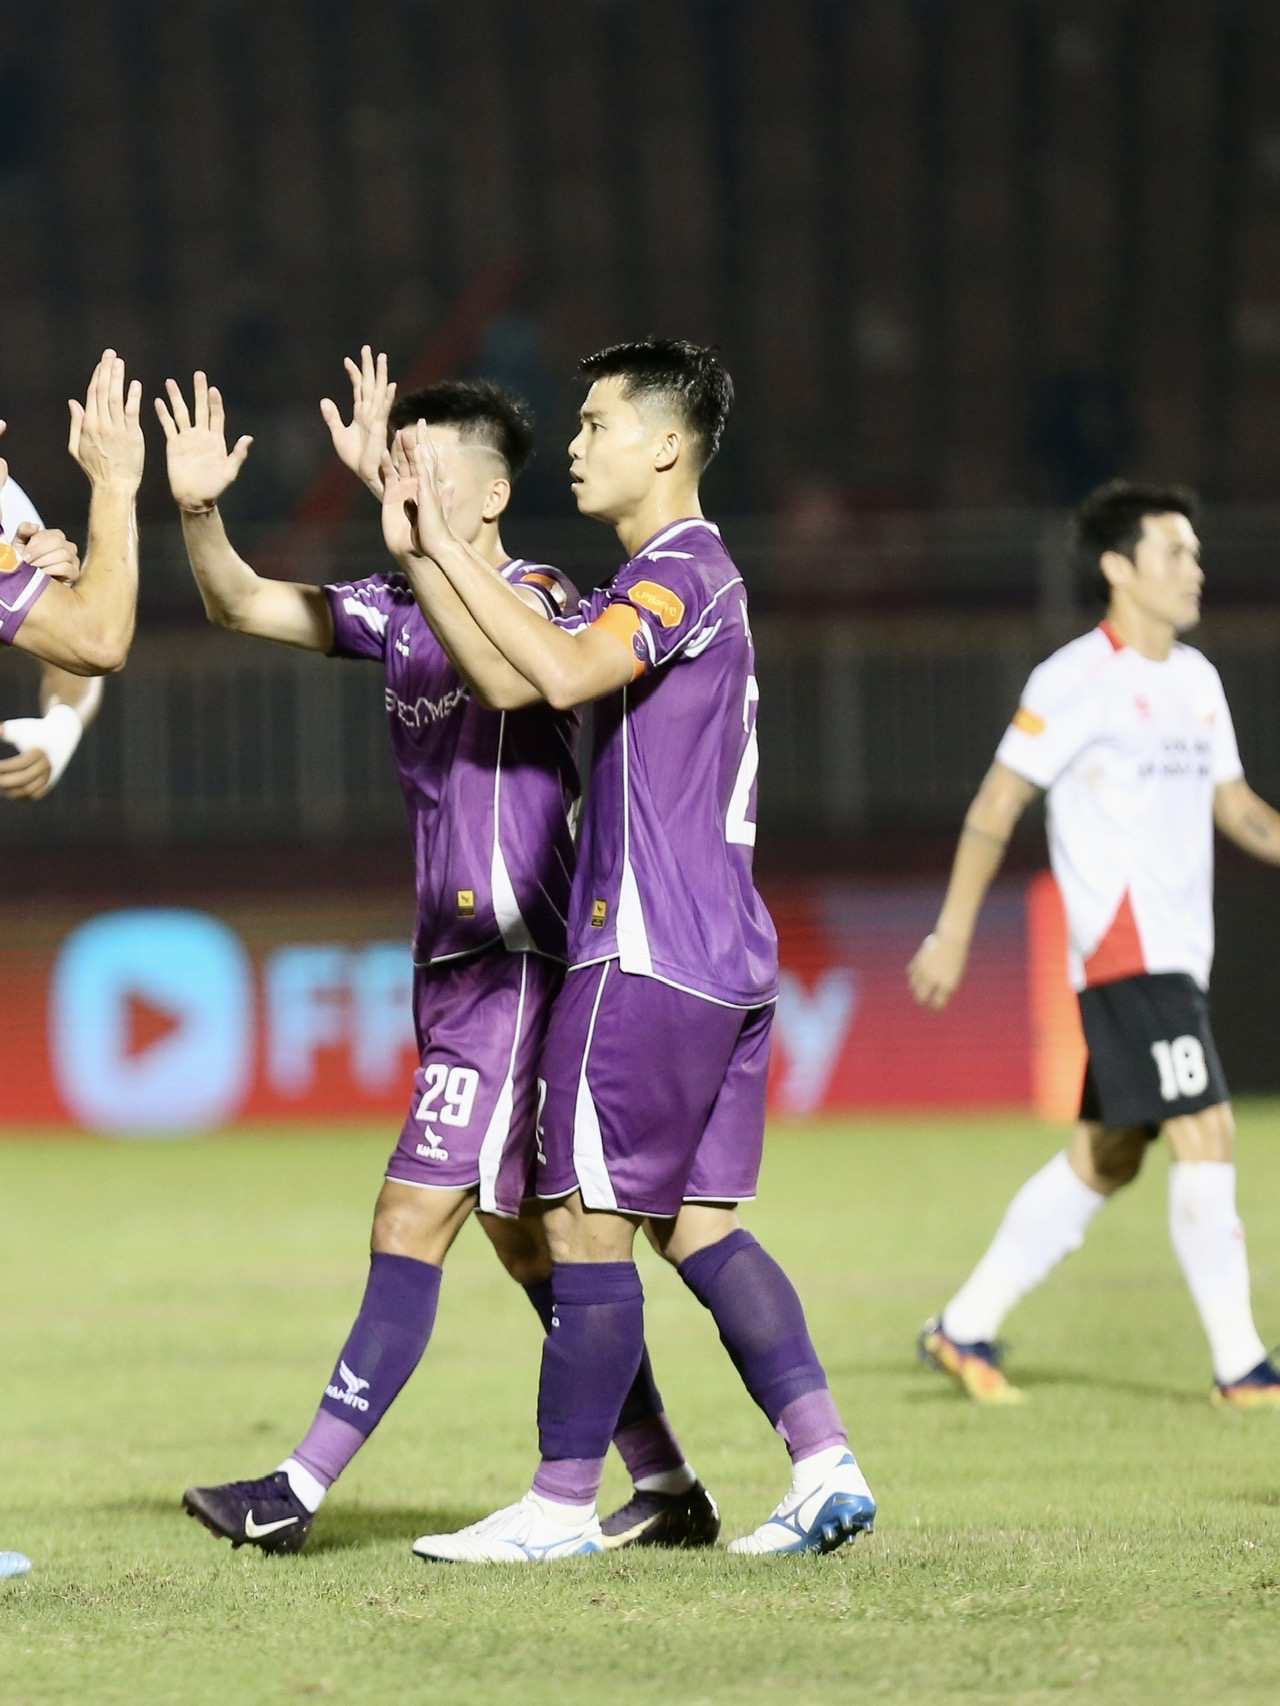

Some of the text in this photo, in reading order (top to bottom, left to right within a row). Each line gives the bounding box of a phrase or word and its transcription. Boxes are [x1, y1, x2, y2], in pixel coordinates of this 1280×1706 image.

[415, 1063, 480, 1128] 29
[1150, 1034, 1210, 1102] 18
[325, 1384, 370, 1412] KAMITO
